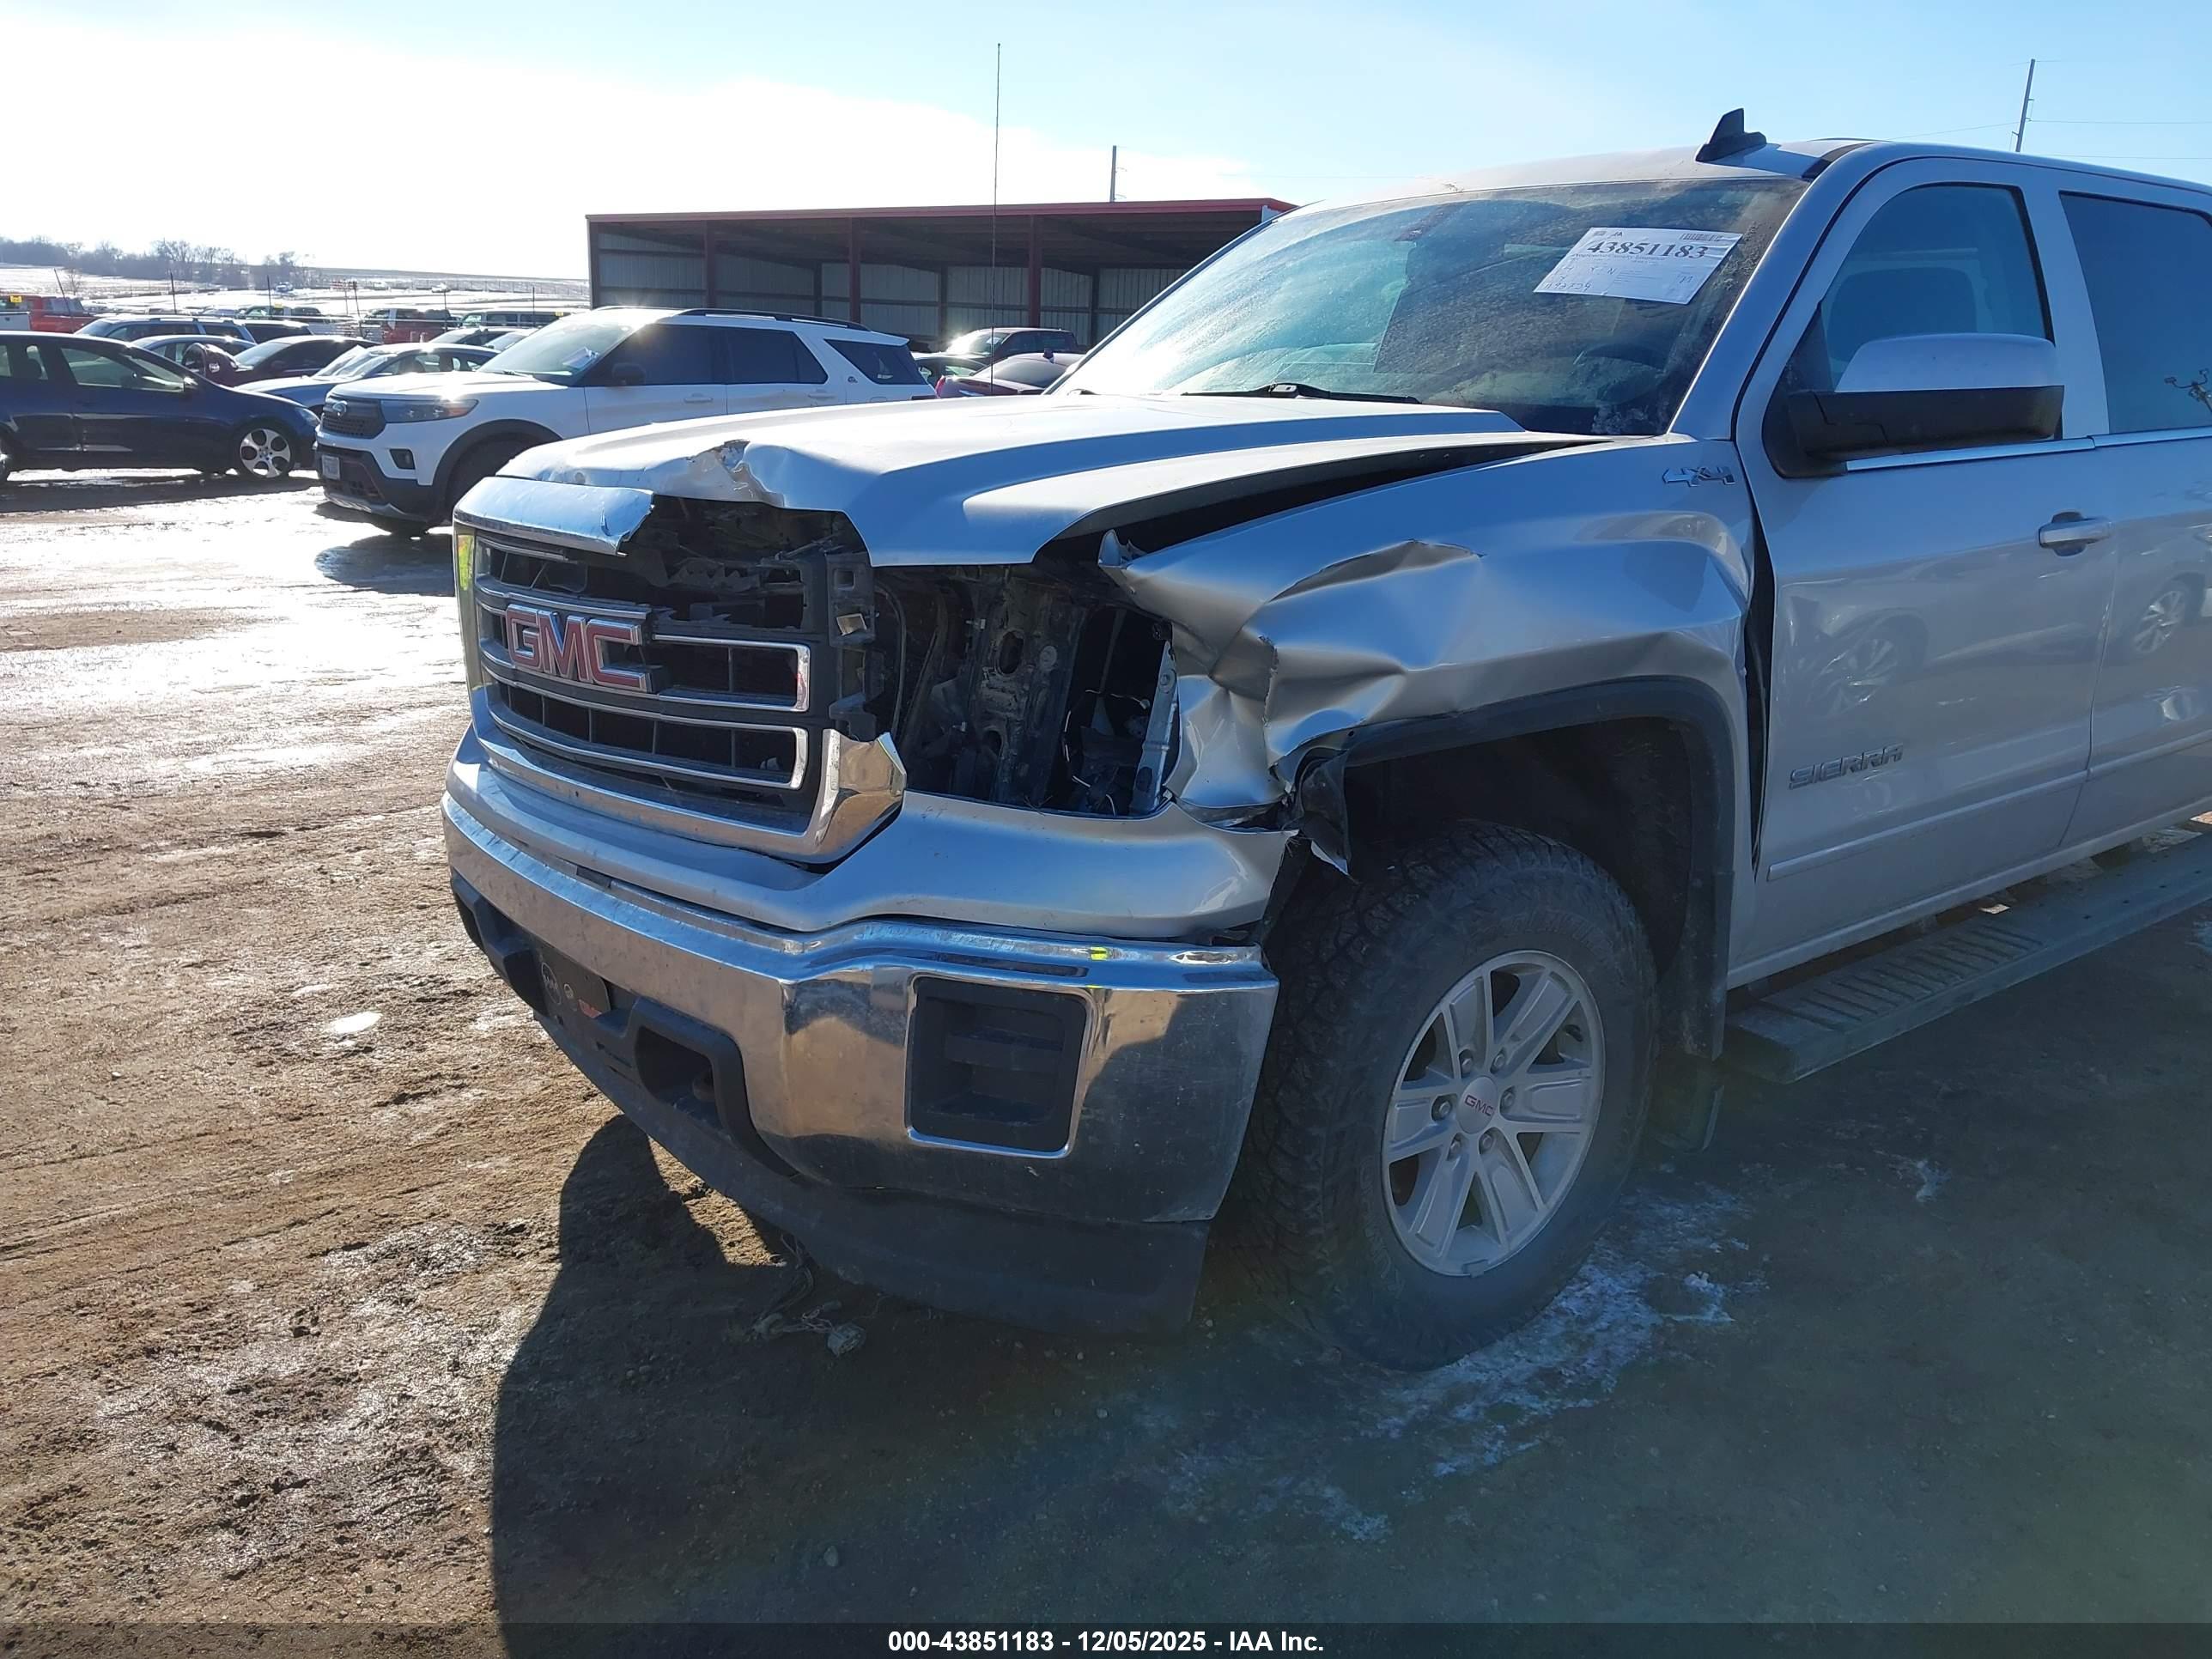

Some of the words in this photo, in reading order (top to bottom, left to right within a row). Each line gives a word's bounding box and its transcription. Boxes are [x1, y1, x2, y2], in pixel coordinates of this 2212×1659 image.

[1587, 240, 1708, 259] 43851183
[506, 604, 652, 694] GMC
[1789, 742, 1904, 791] SIERRA
[1464, 1094, 1496, 1117] GMC
